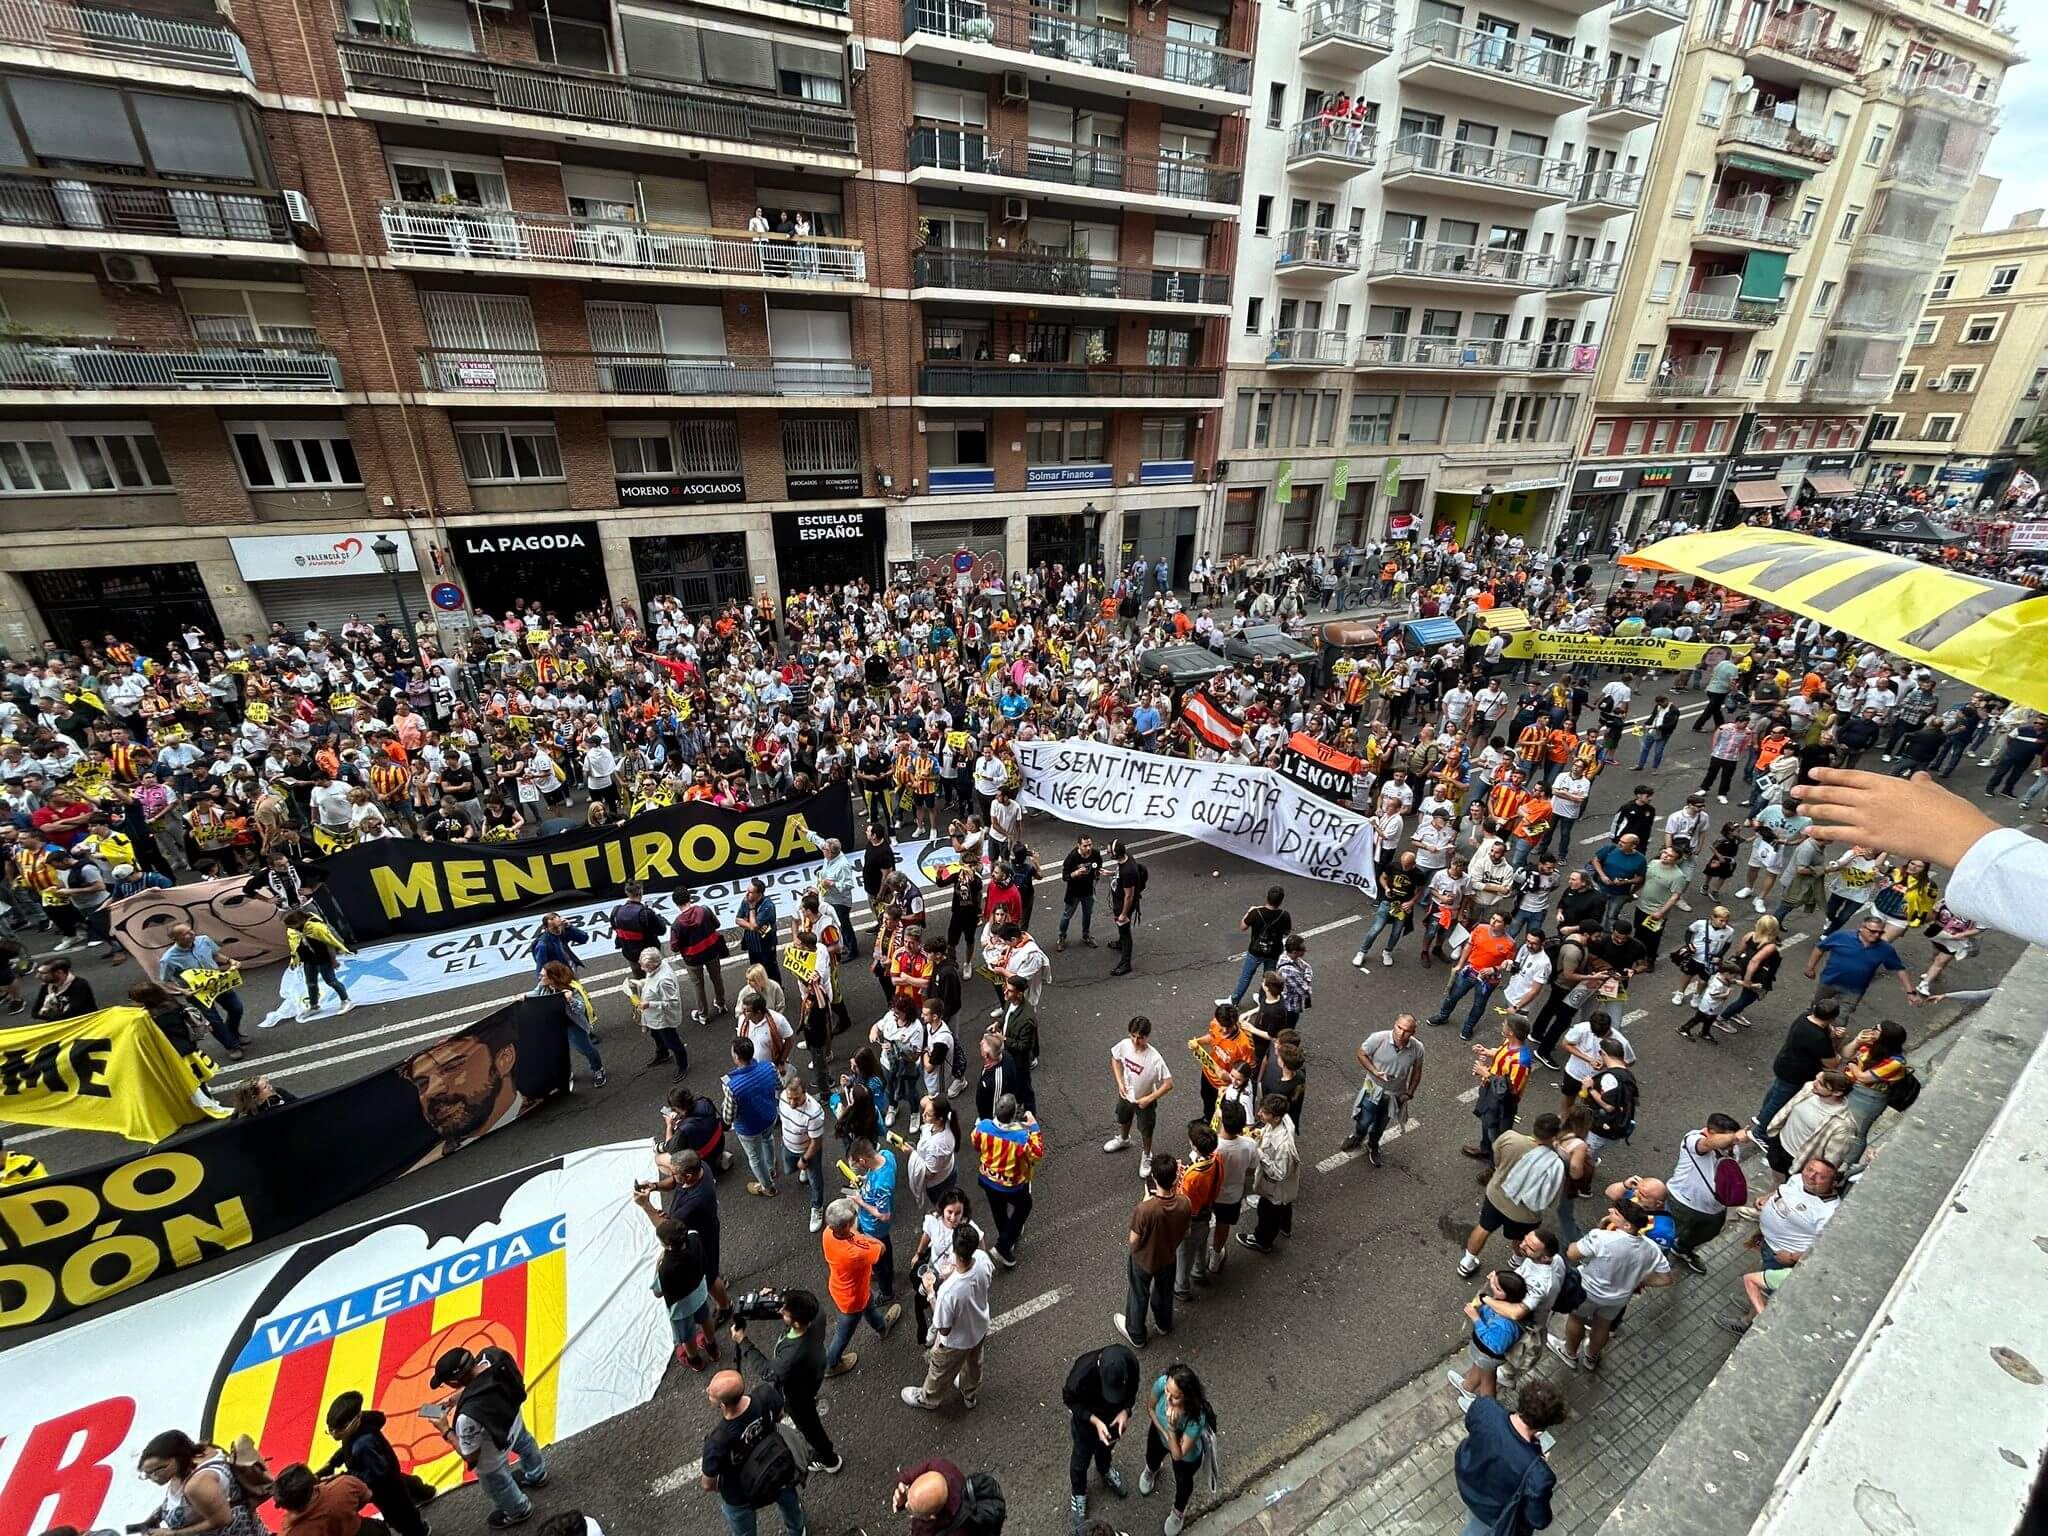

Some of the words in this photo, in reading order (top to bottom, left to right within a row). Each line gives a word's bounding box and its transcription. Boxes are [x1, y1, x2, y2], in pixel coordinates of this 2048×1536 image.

[1028, 470, 1060, 481] Solmar
[1061, 469, 1095, 480] Finance
[621, 486, 670, 497] MORENO
[682, 483, 742, 495] ASOCIADOS
[797, 514, 847, 526] ESCUELA
[848, 513, 863, 524] DE
[799, 524, 864, 541] ESPAÑOL
[466, 539, 495, 554] LA
[499, 533, 585, 552] PAGODA
[306, 552, 340, 561] VALENCIA
[1599, 638, 1607, 646] Y
[1532, 652, 1586, 662] MESTALLA
[1587, 655, 1616, 664] CASA
[1617, 656, 1664, 667] NOSTRA
[1020, 749, 1043, 771] EL
[1294, 796, 1361, 844] FORA
[1024, 778, 1045, 801] EL
[1144, 794, 1178, 819] ES
[1191, 800, 1270, 846] QUEDA
[370, 813, 818, 920] MENTIROSA
[427, 895, 669, 959] CAIXBAK
[443, 954, 487, 974] EL
[0, 1152, 205, 1251] DO
[265, 1234, 534, 1354] VALENCIA
[0, 1395, 137, 1536] R
